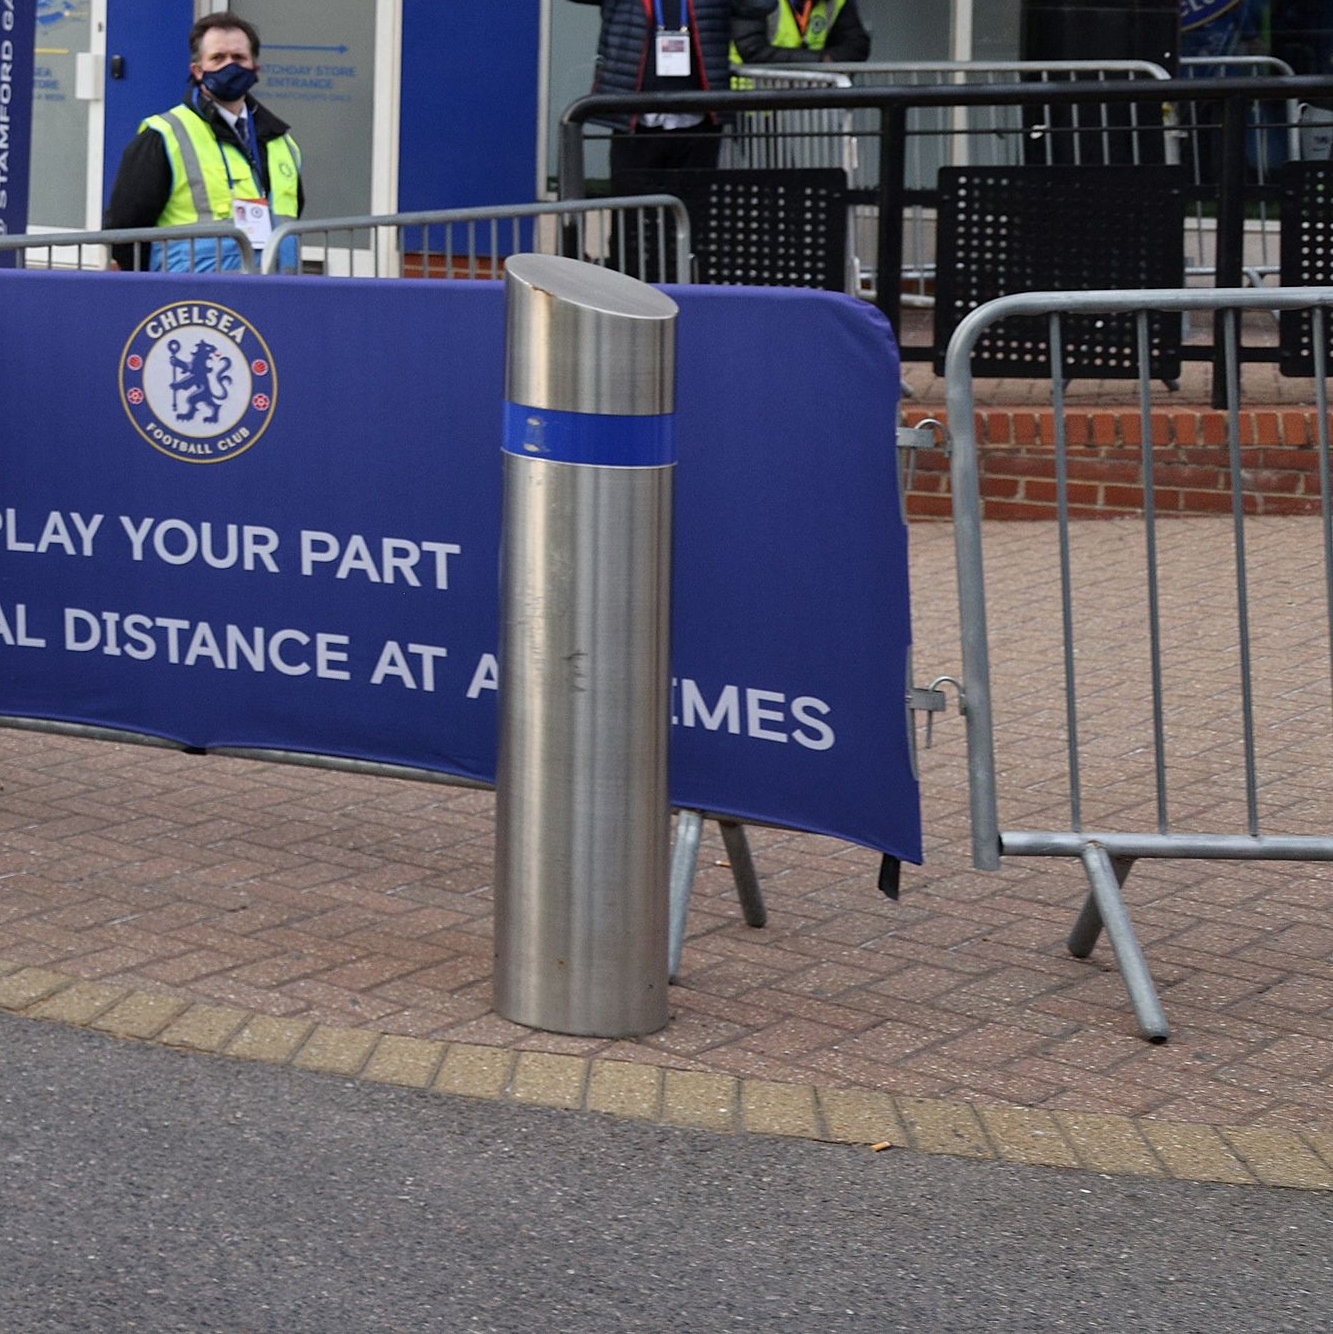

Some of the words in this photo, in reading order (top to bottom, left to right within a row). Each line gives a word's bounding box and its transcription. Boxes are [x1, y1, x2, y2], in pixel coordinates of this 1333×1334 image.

[145, 306, 247, 345] CHELSEA
[145, 422, 214, 456] FOOTBALL
[217, 426, 251, 451] CLUB
[120, 515, 280, 574] YOUR
[300, 530, 461, 591] PART
[64, 608, 351, 681] DISTANCE
[370, 641, 448, 692] AT
[671, 676, 835, 751] MES
